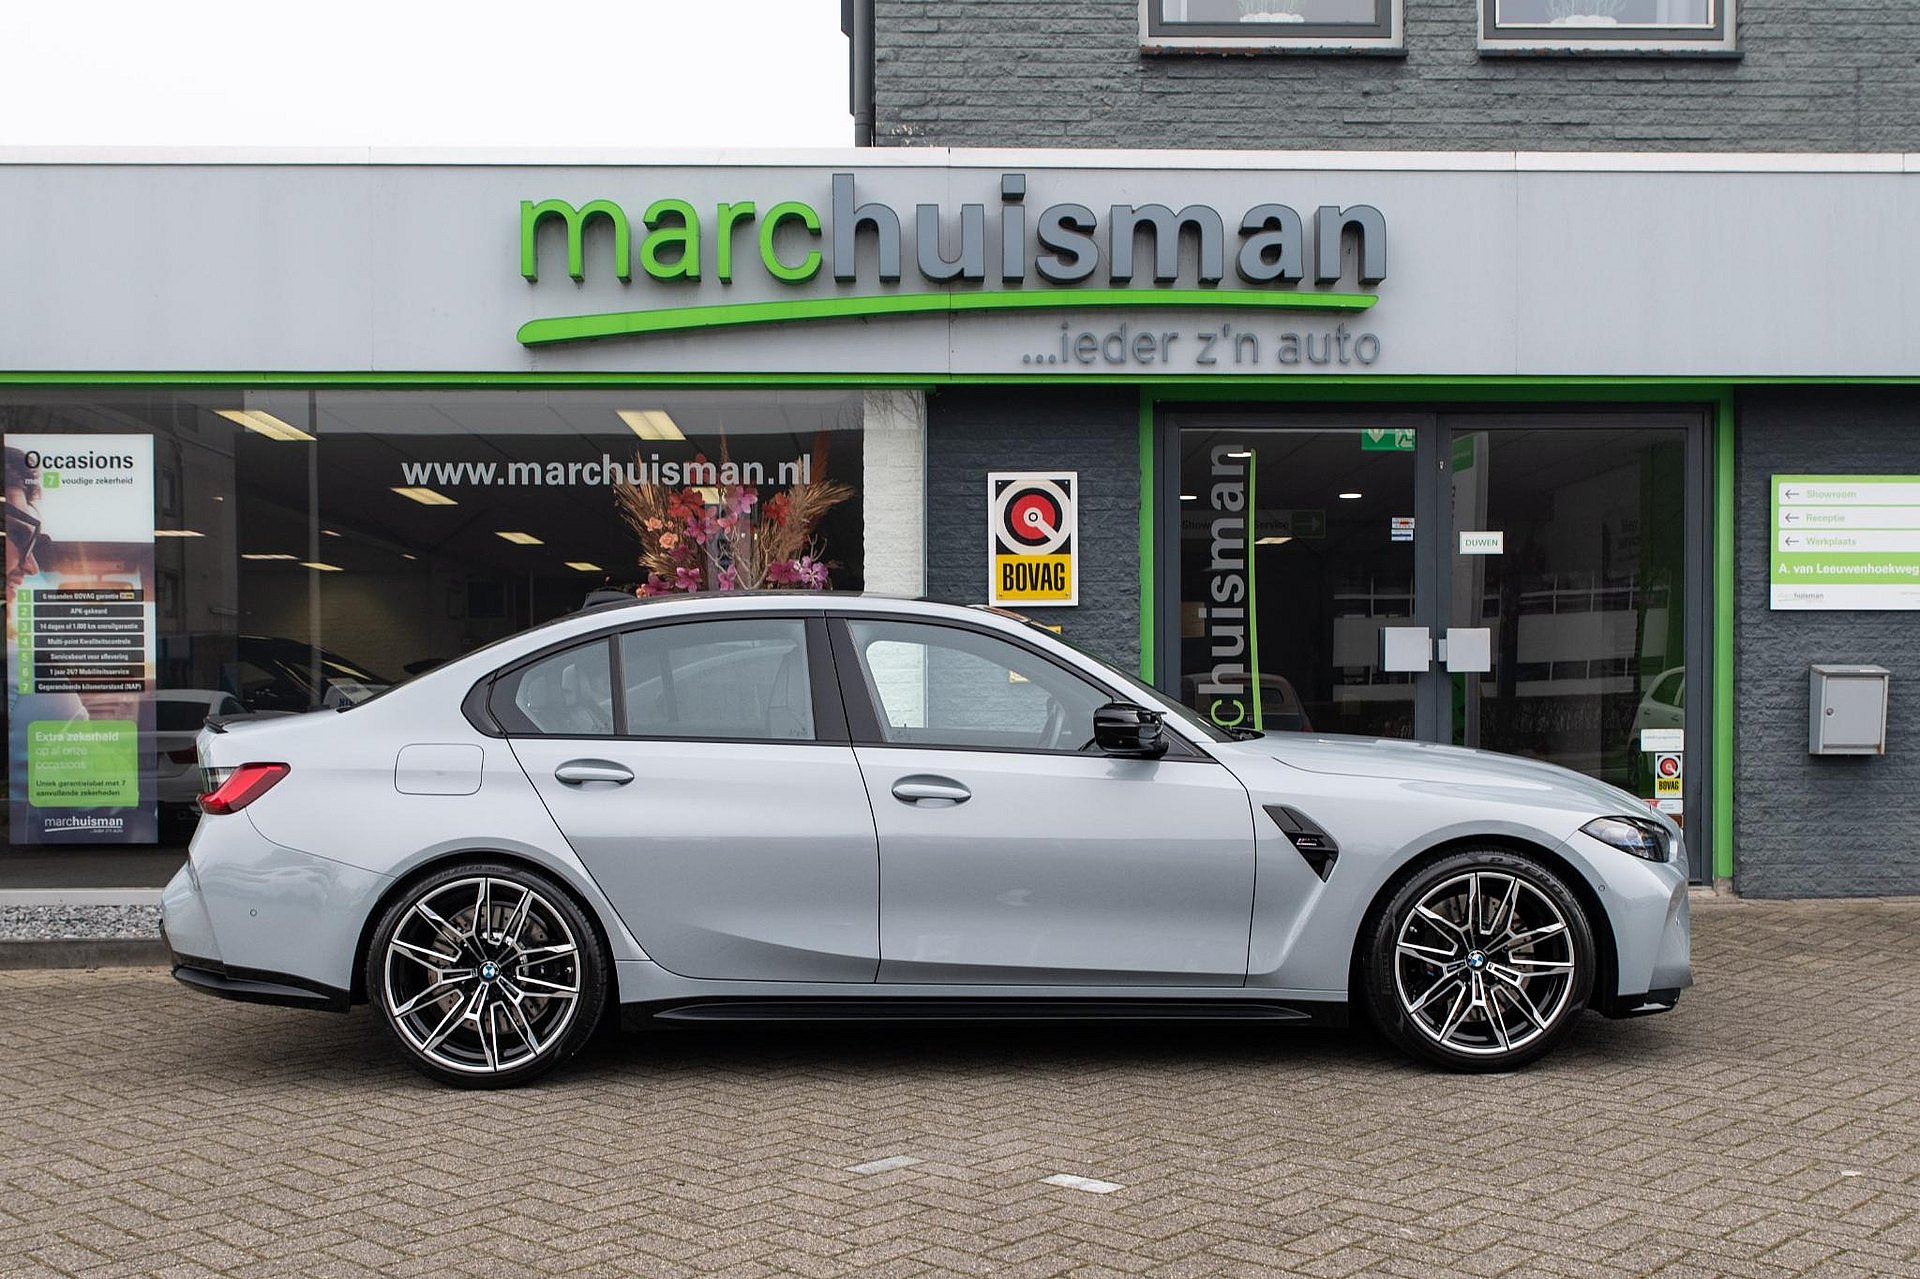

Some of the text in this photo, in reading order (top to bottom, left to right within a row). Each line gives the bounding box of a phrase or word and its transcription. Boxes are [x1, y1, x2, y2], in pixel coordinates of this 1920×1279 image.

[519, 173, 1387, 284] marchuisman
[1022, 321, 1381, 365] ...ieder z'n auto
[25, 450, 134, 469] Occasions
[401, 453, 812, 487] www.marchuisman.nl
[61, 476, 94, 486] voudige
[95, 476, 133, 485] zekerheid
[1806, 489, 1857, 499] Showroom
[1806, 513, 1846, 523] Receptie
[1465, 539, 1498, 547] DUWEN
[1806, 537, 1857, 547] Werkplaats
[1778, 563, 1920, 576] A. van Leeuwenhoekweg
[1002, 562, 1065, 591] BOVAG
[1198, 444, 1246, 728] chuisman
[35, 732, 65, 742] Extra
[1658, 780, 1679, 791] BOVAG
[45, 815, 124, 827] marchuisman
